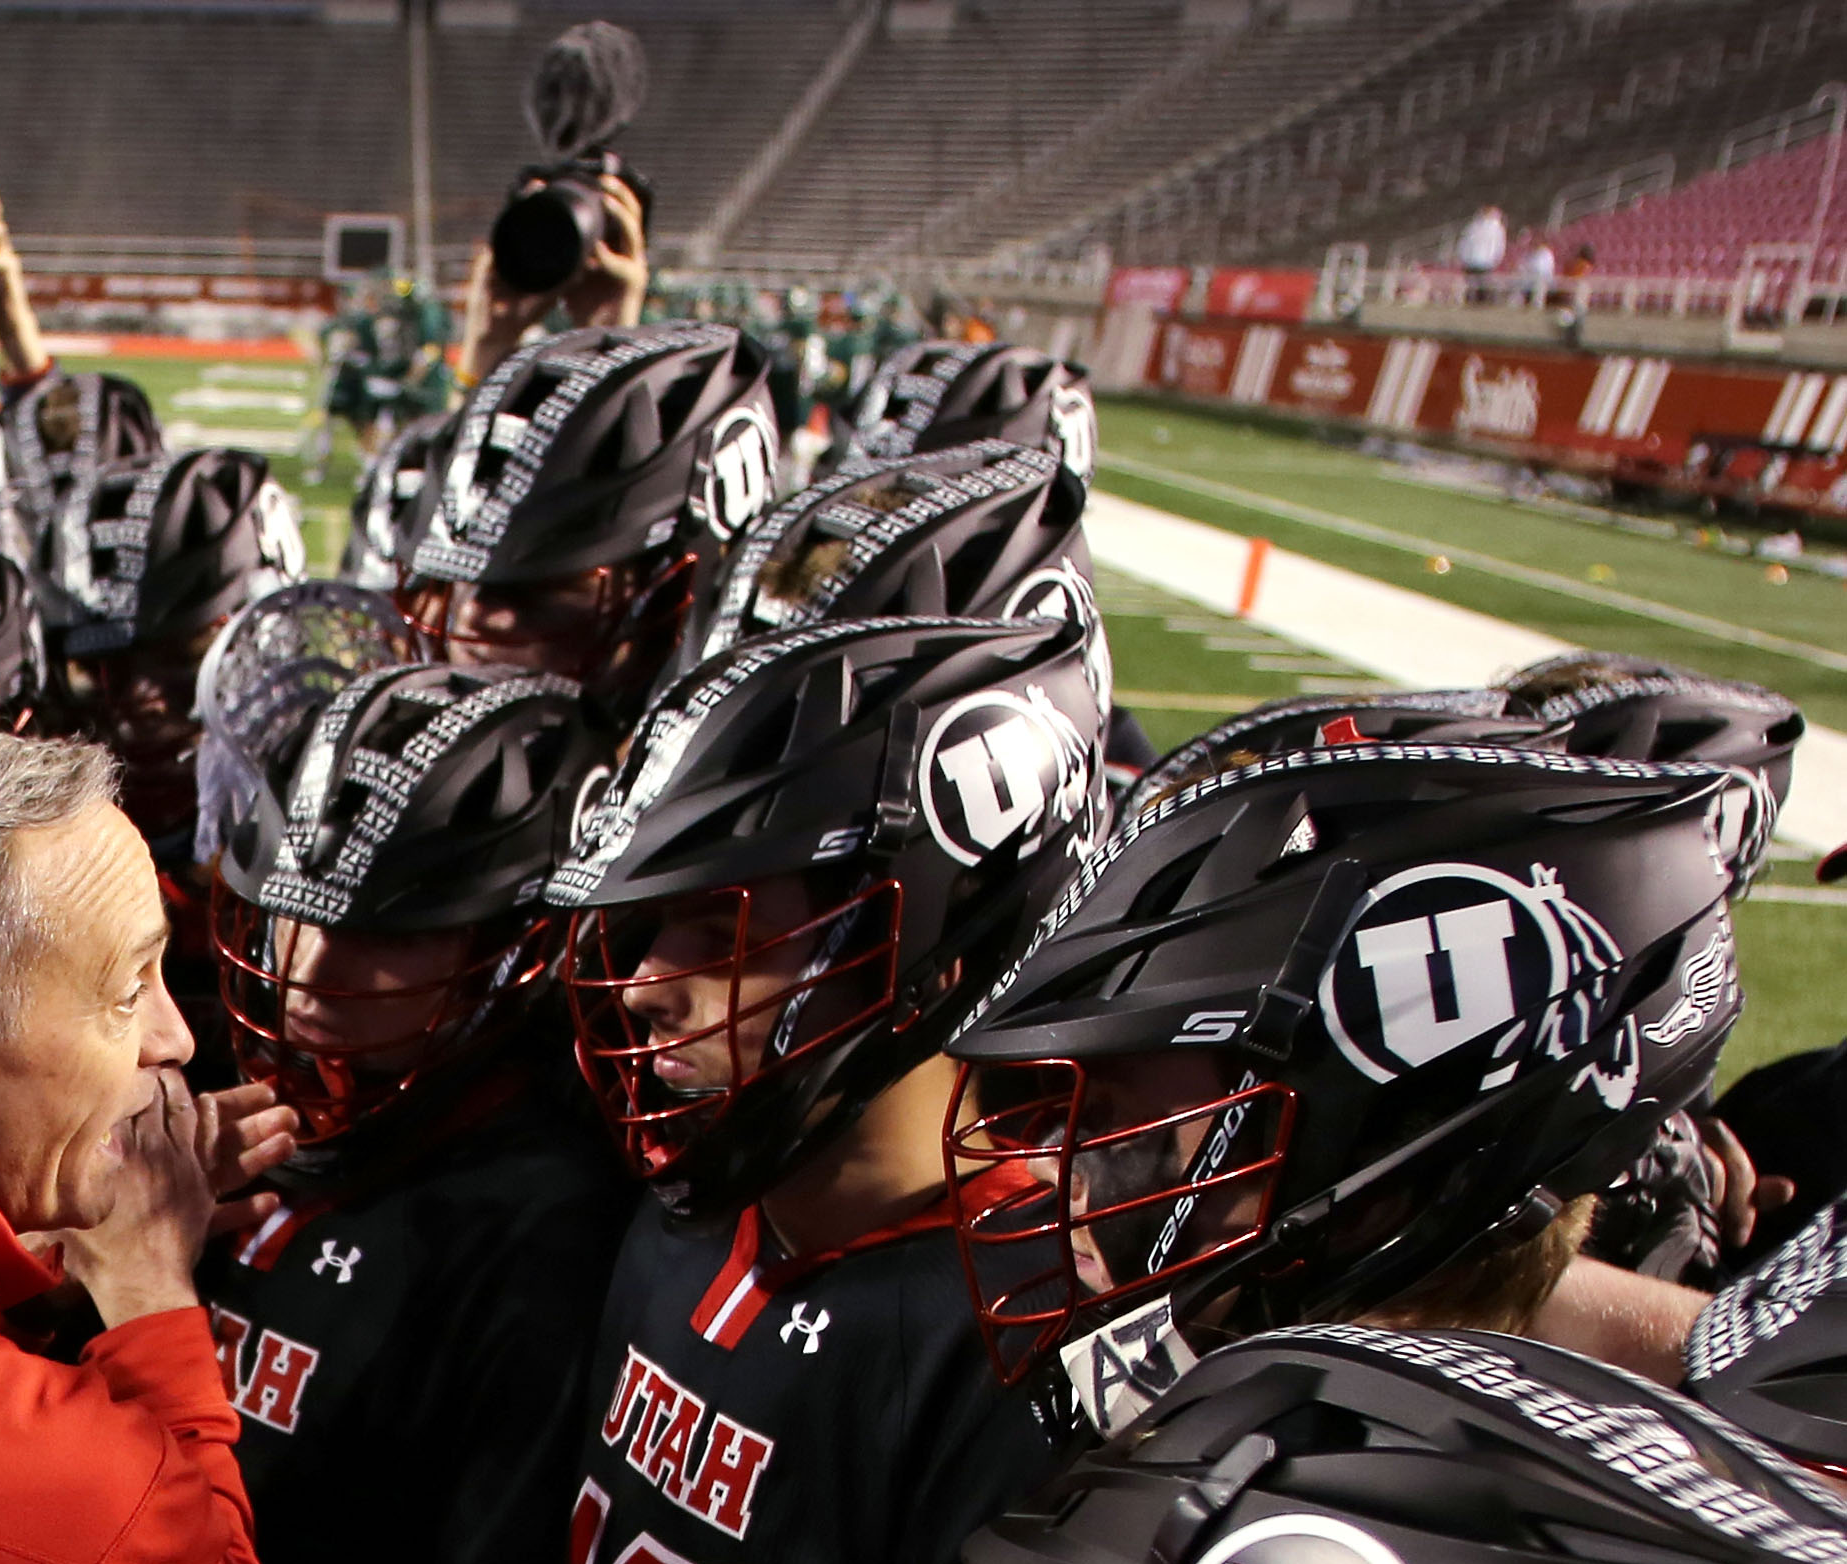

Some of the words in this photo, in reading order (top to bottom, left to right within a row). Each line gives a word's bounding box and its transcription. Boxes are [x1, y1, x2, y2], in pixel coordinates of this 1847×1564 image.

[713, 420, 769, 521] U
[937, 714, 1045, 852] U
[1355, 899, 1519, 1068] U
[602, 1343, 776, 1541] UTAH
